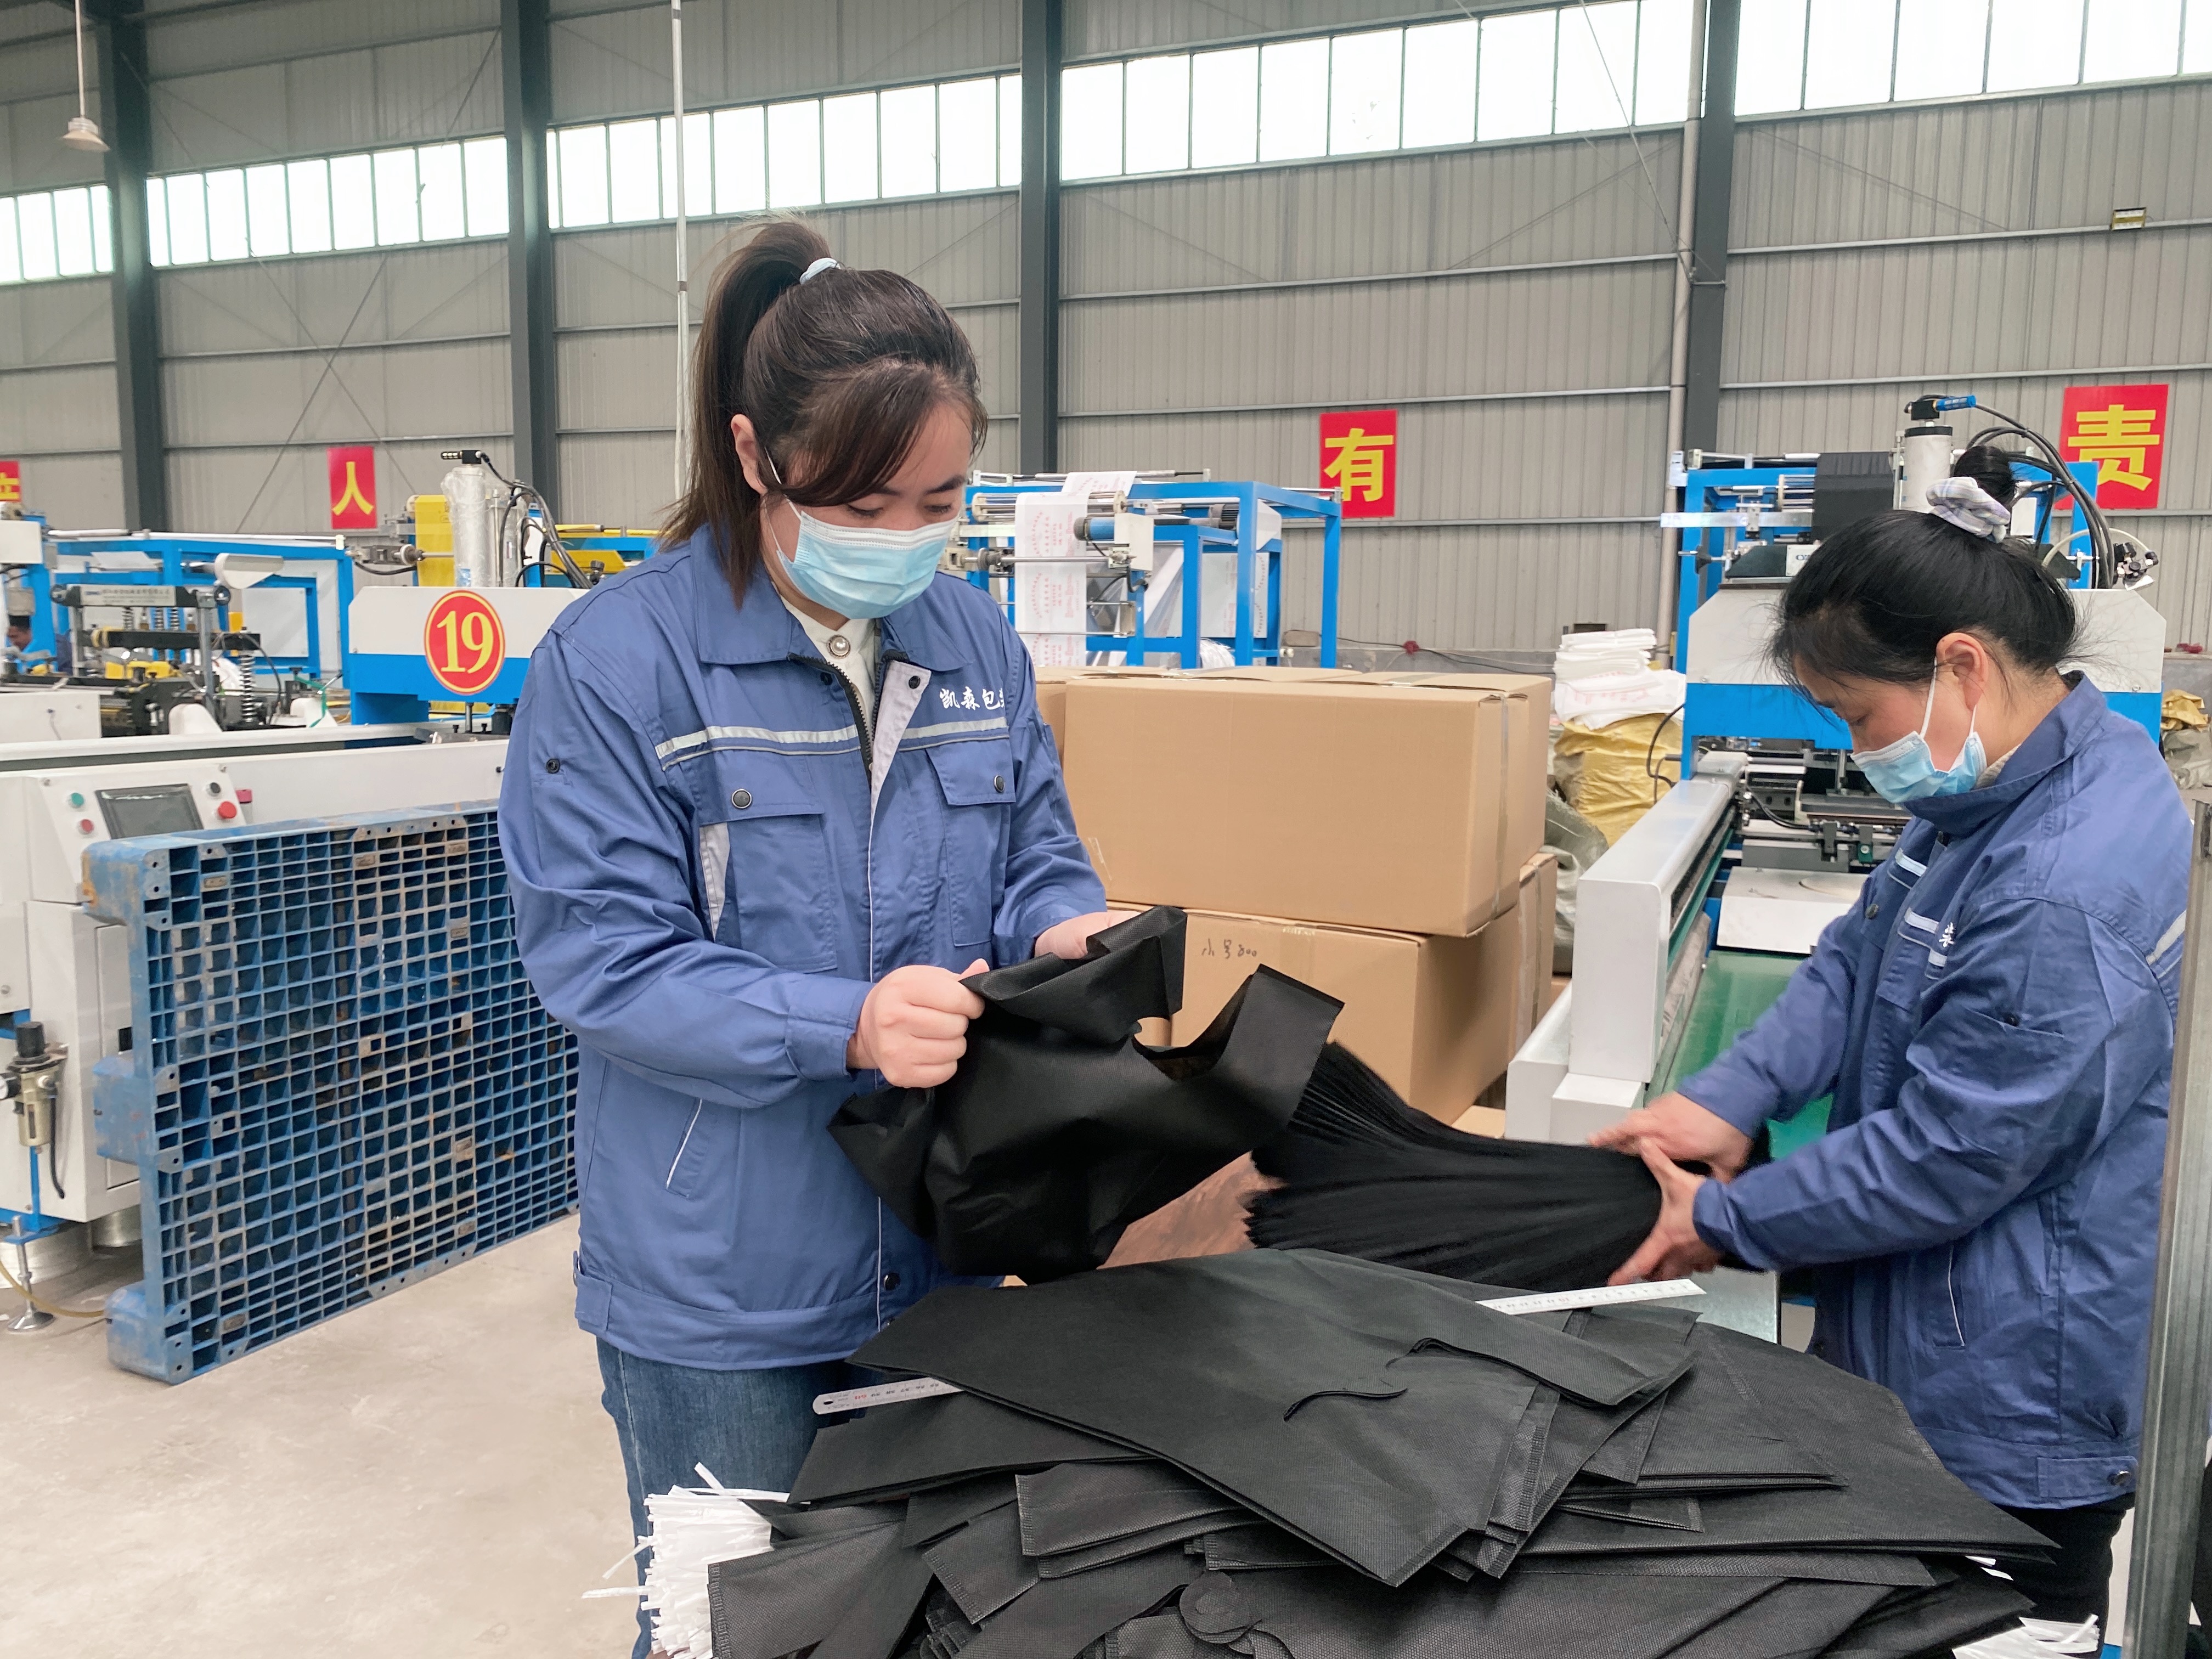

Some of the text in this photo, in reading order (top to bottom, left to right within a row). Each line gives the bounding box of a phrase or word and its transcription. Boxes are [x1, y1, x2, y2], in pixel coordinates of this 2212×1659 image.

[1323, 428, 1394, 502] 有
[2068, 404, 2160, 491] 责
[332, 461, 374, 516] 人
[437, 610, 494, 674] 19
